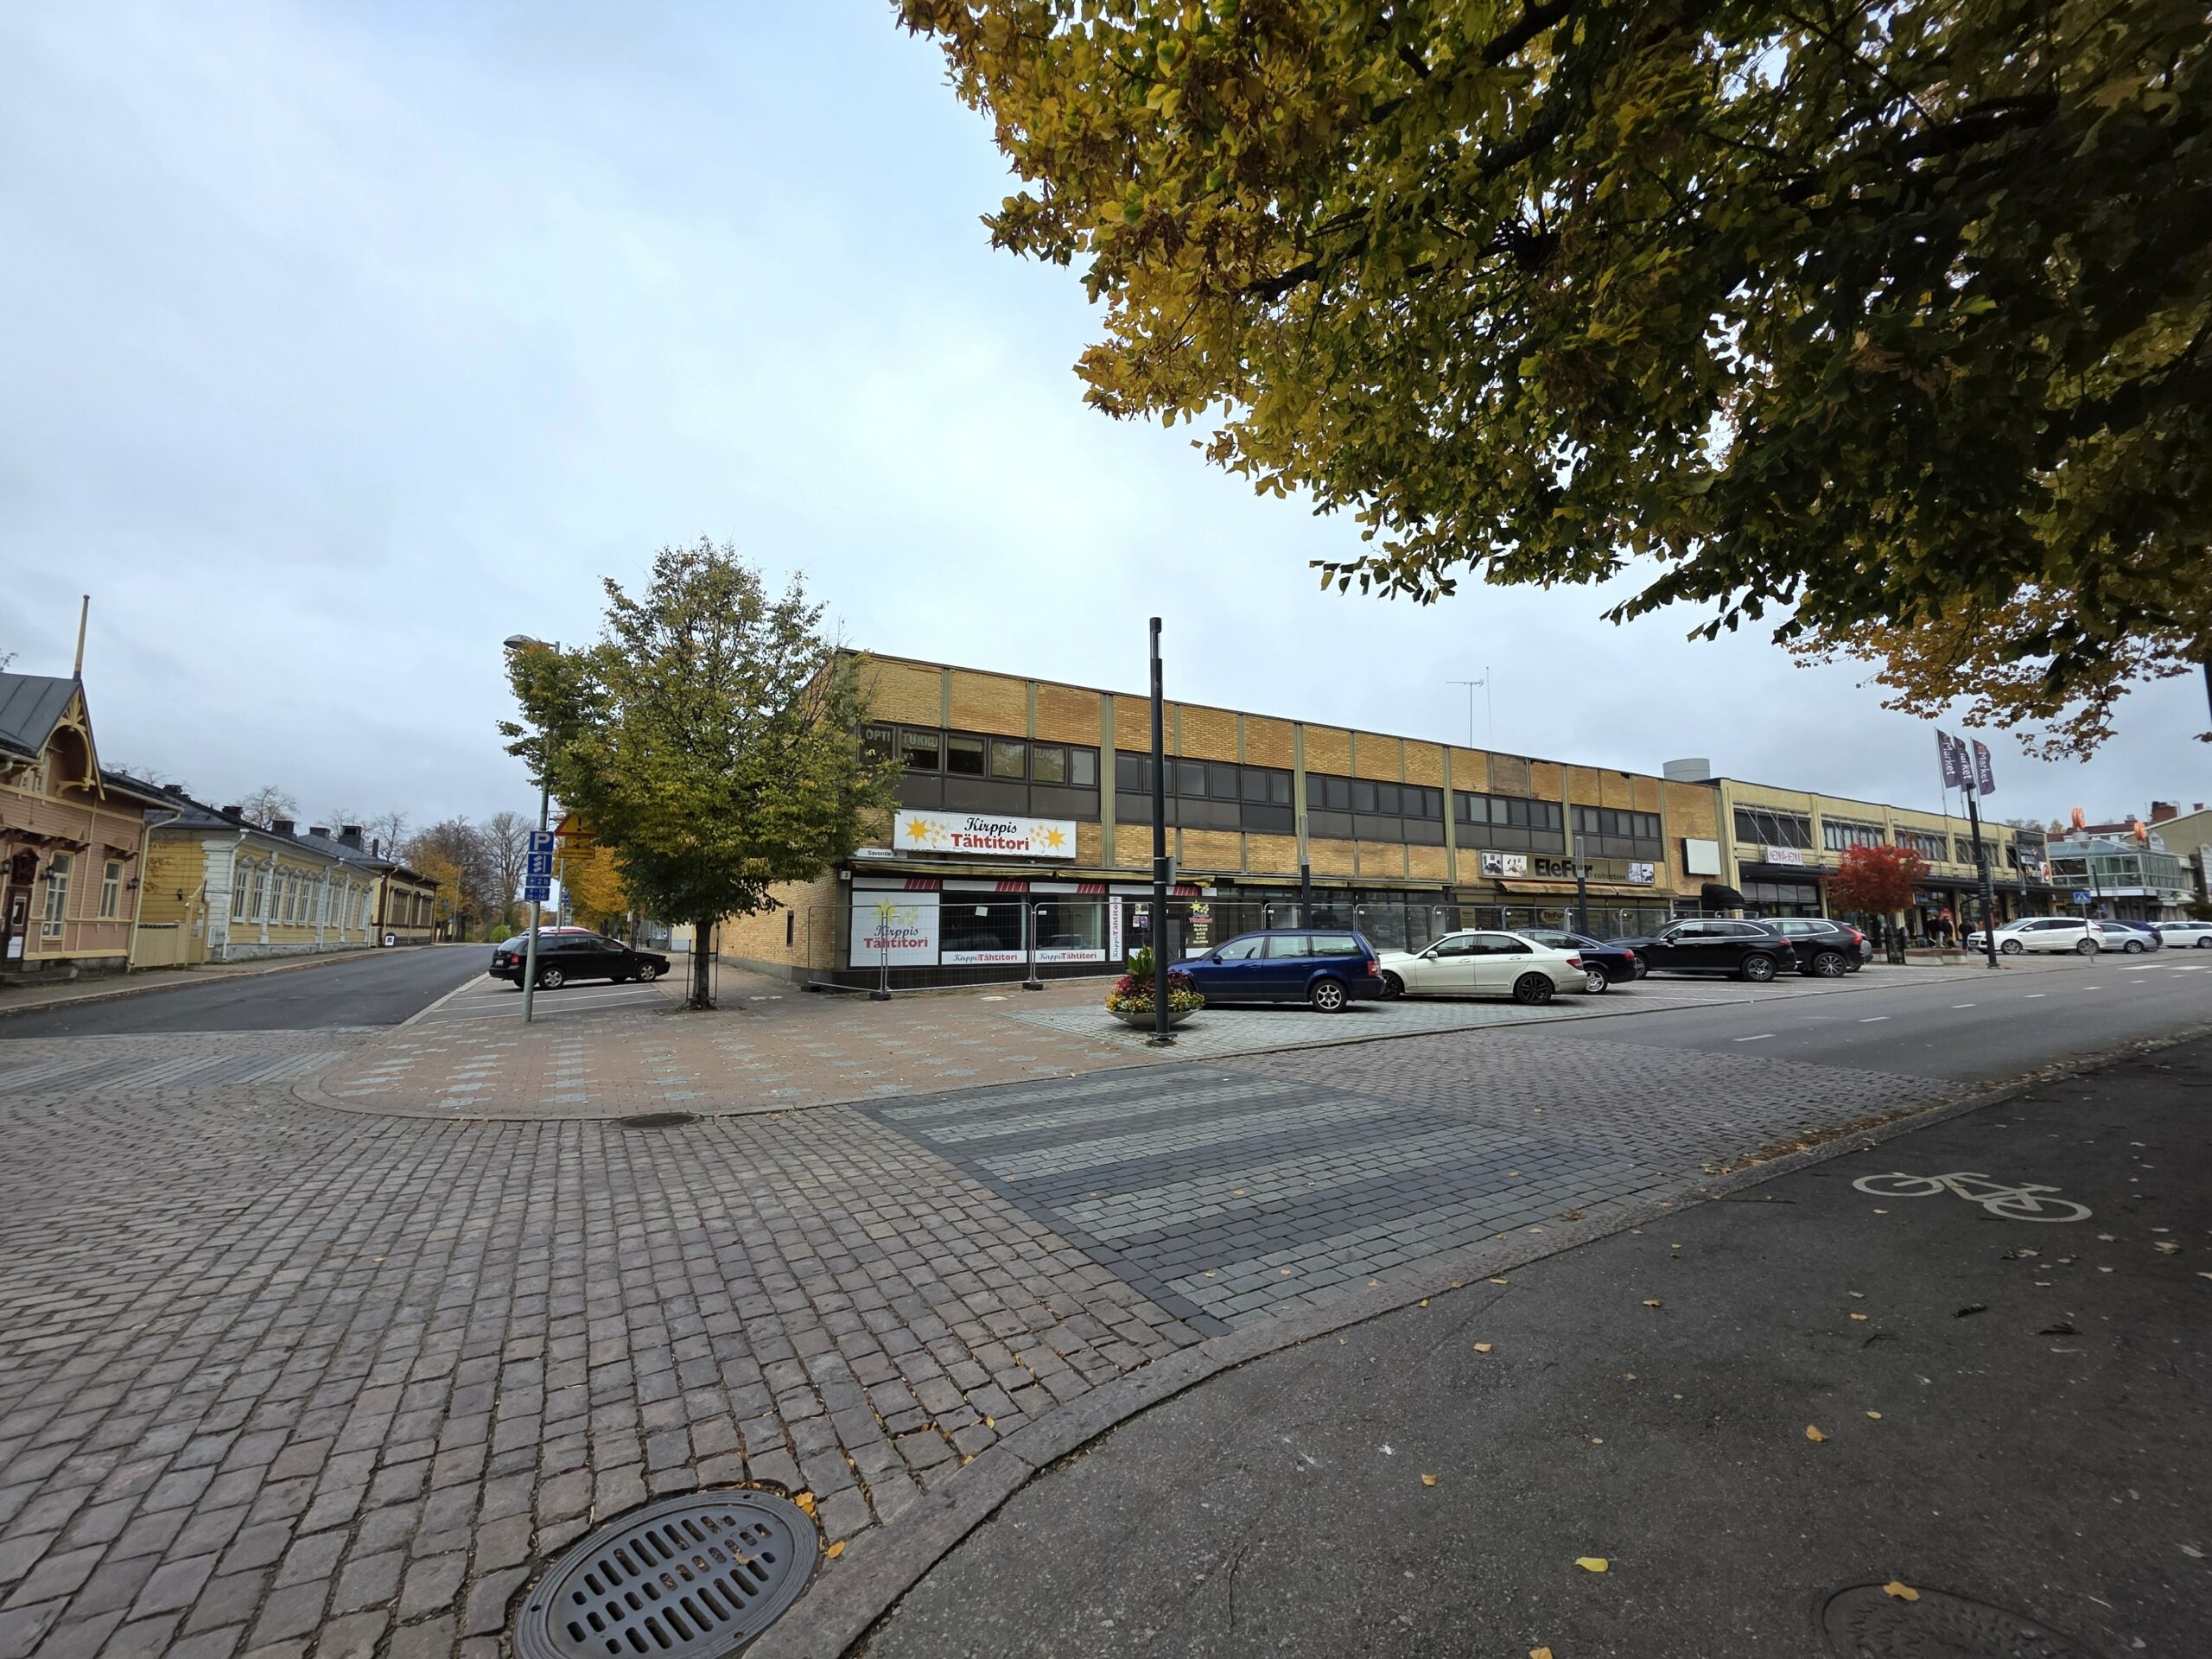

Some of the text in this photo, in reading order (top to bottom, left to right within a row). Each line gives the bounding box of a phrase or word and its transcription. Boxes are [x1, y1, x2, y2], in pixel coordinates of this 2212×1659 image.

[866, 728, 938, 747] OPTI TUKKU
[1942, 742, 1956, 775] Market
[1978, 752, 1991, 784] Market
[964, 817, 1018, 836] Kirppis
[534, 832, 551, 851] P
[951, 834, 1030, 850] Tähtitori
[863, 937, 928, 949] Tähtitori
[977, 953, 1018, 962] Tähtitori
